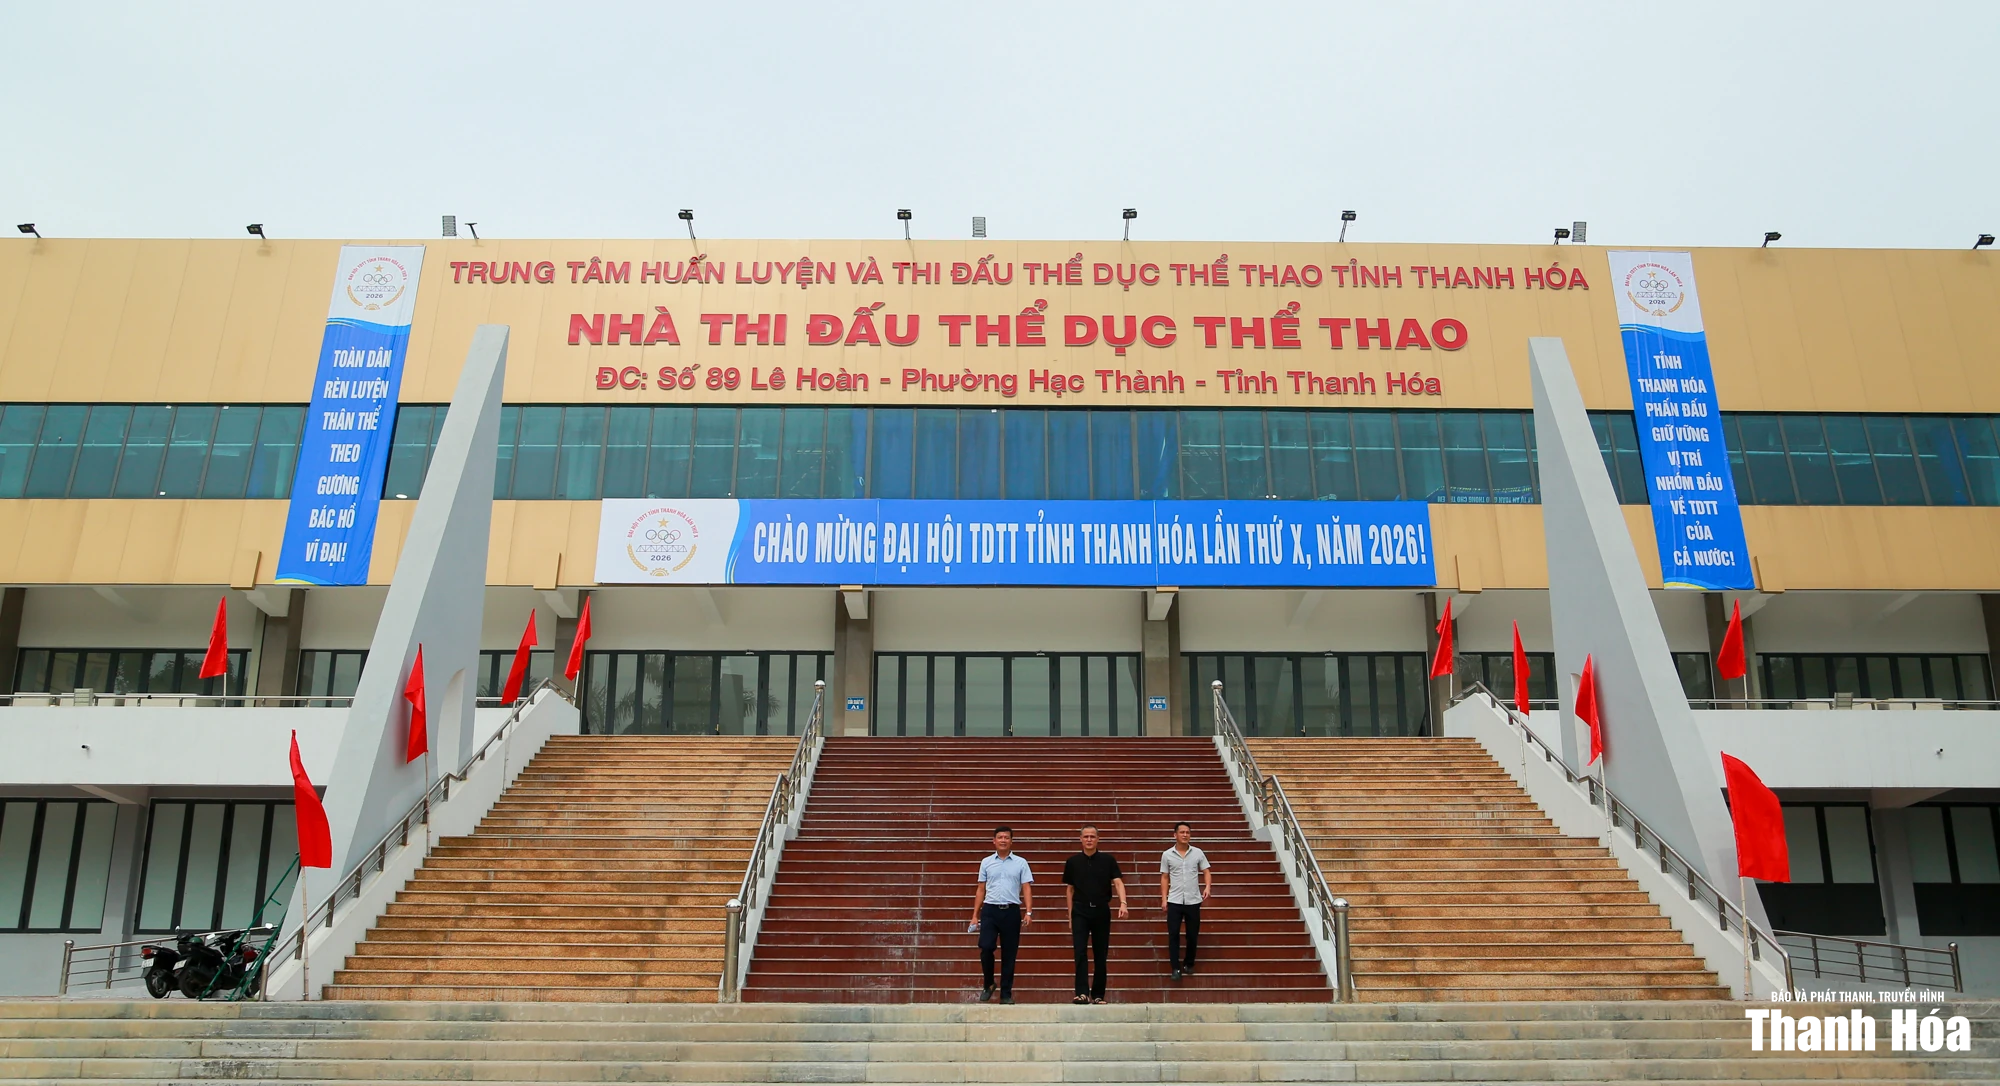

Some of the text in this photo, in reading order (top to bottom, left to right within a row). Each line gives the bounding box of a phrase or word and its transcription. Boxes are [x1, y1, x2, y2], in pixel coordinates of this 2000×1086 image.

[450, 252, 1589, 291] TRUNG TÂM HUẤN LUYỆN VÀ THI ĐẤU THỂ DỤC THỂ THAO TỈNH THANH HÓA
[567, 299, 1469, 356] NHÀ THI ĐẤU THỂ DỤC THỂ THAO
[333, 347, 392, 368] TOÀN DÂN
[1653, 351, 1682, 370] TỈNH
[323, 377, 388, 405] RÈN LUYỆN
[596, 366, 647, 390] ĐC:
[657, 363, 699, 390] Số
[706, 367, 740, 390] 89
[752, 366, 785, 390] Lê
[796, 367, 869, 391] Hoàn
[902, 368, 1018, 396] Phường
[1029, 369, 1085, 398] Hạc
[1095, 369, 1184, 393] Thành
[1217, 368, 1278, 393] Tỉnh
[1287, 370, 1376, 394] Thanh
[1386, 370, 1441, 396] Hóa
[1638, 377, 1707, 394] THANH HÓA
[322, 405, 382, 431] THÂN THỂ
[1645, 398, 1707, 418] PHẤN ĐẤU
[1652, 425, 1709, 443] GIỮ VỮNG
[330, 443, 360, 463] THEO
[1667, 450, 1702, 468] VỊ TRÍ
[316, 474, 360, 496] GƯƠNG
[1656, 471, 1723, 491] NHÓM ĐẦU
[308, 503, 356, 529] BÁC HỒ
[1670, 496, 1718, 516] VỀ TDTT
[754, 509, 1427, 573] CHÀO MỪNG ĐẠI HỘI TDTT TỈNH THANH HÓA LẦN THỨ X, NĂM 2026!
[1685, 521, 1713, 541] CỦA
[305, 538, 348, 567] VĨ ĐẠI!
[650, 554, 672, 562] 2026
[1673, 544, 1736, 567] CẢ NƯỚC!
